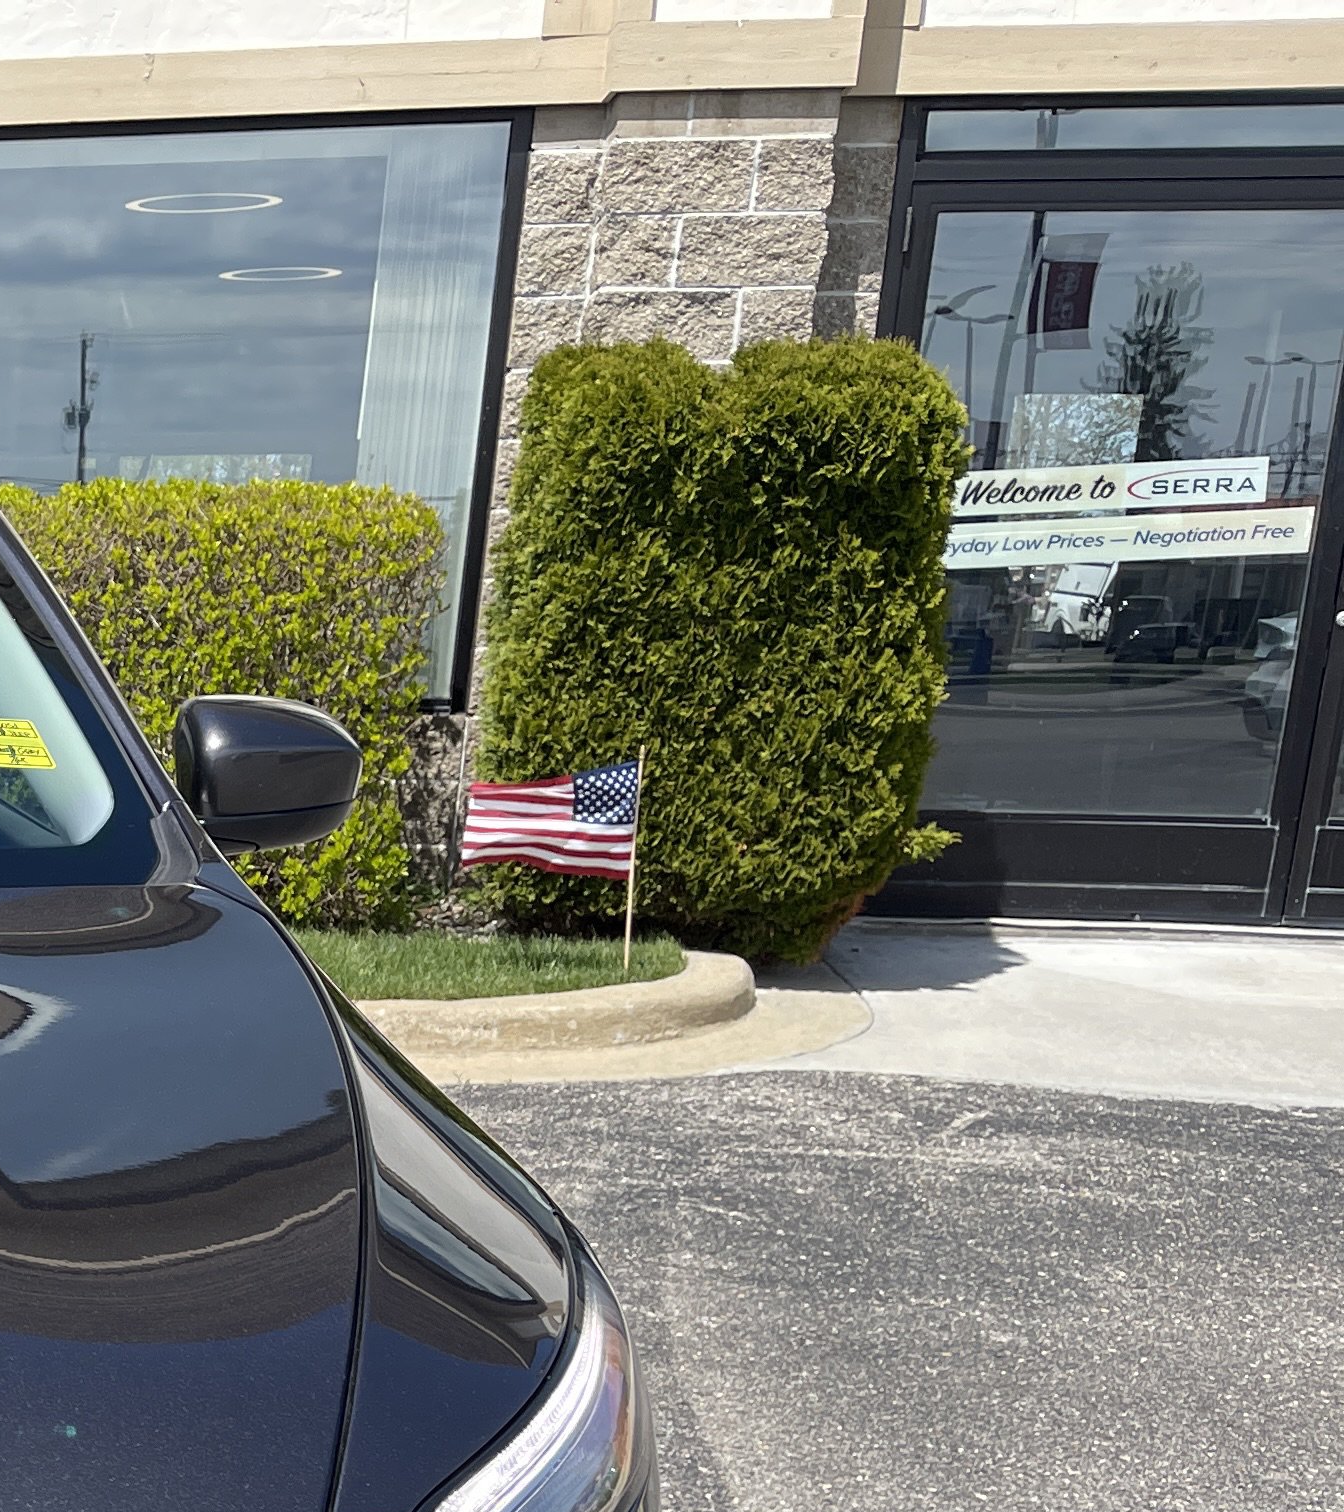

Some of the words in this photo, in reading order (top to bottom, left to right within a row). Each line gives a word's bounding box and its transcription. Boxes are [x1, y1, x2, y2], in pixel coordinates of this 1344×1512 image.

[960, 478, 1083, 506] Welcome
[1090, 474, 1115, 499] to
[1151, 477, 1257, 495] SERRA
[1002, 537, 1043, 552] Low
[1046, 533, 1105, 550] Prices
[1133, 526, 1245, 548] Negotiation
[1251, 525, 1295, 540] Free
